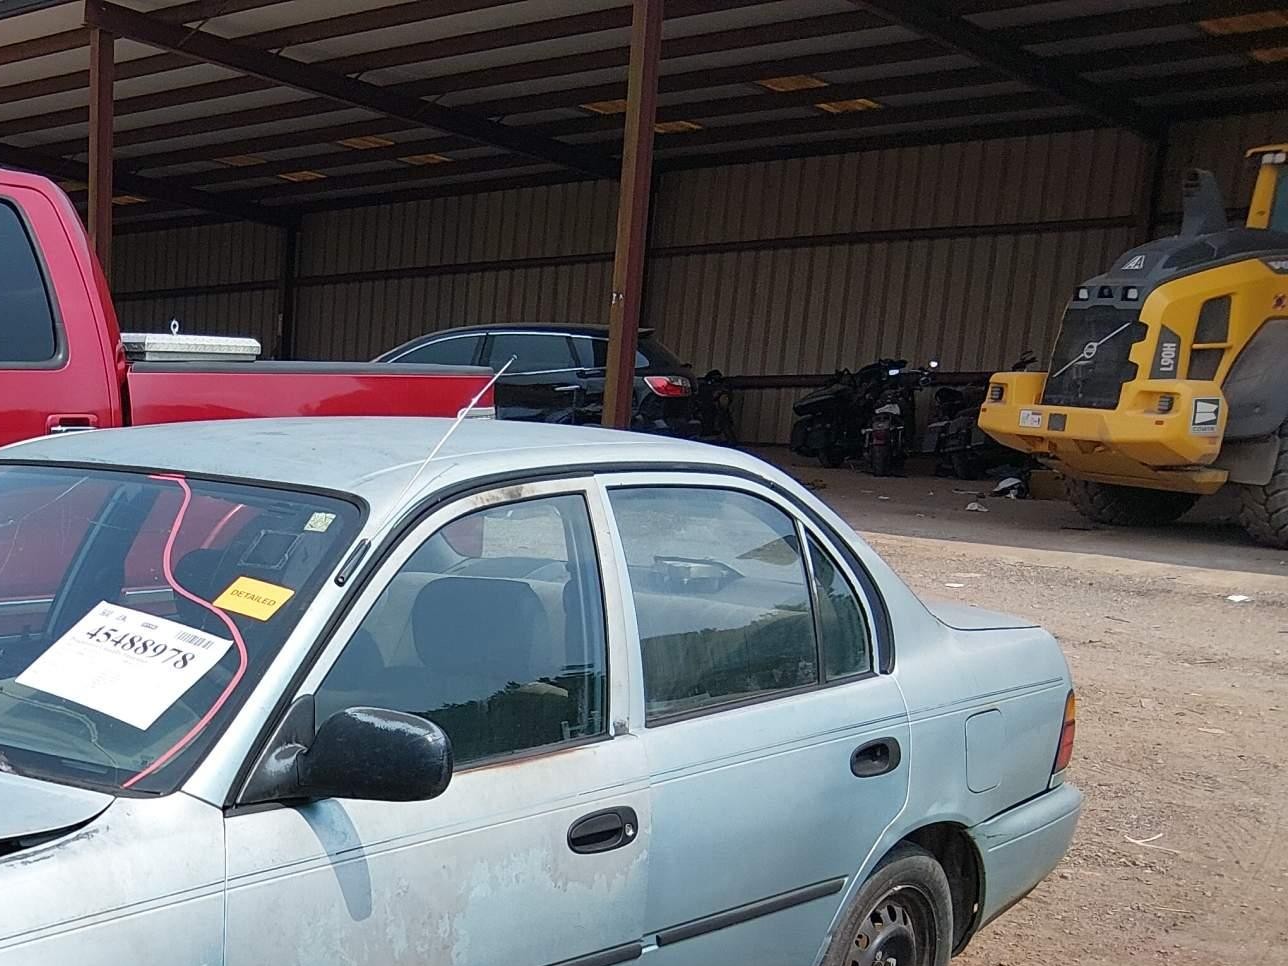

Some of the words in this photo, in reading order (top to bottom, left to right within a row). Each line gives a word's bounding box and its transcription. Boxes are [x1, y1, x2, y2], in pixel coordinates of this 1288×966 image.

[1159, 343, 1177, 371] L90H
[230, 589, 277, 606] DETAILED
[86, 625, 196, 669] 45488978
